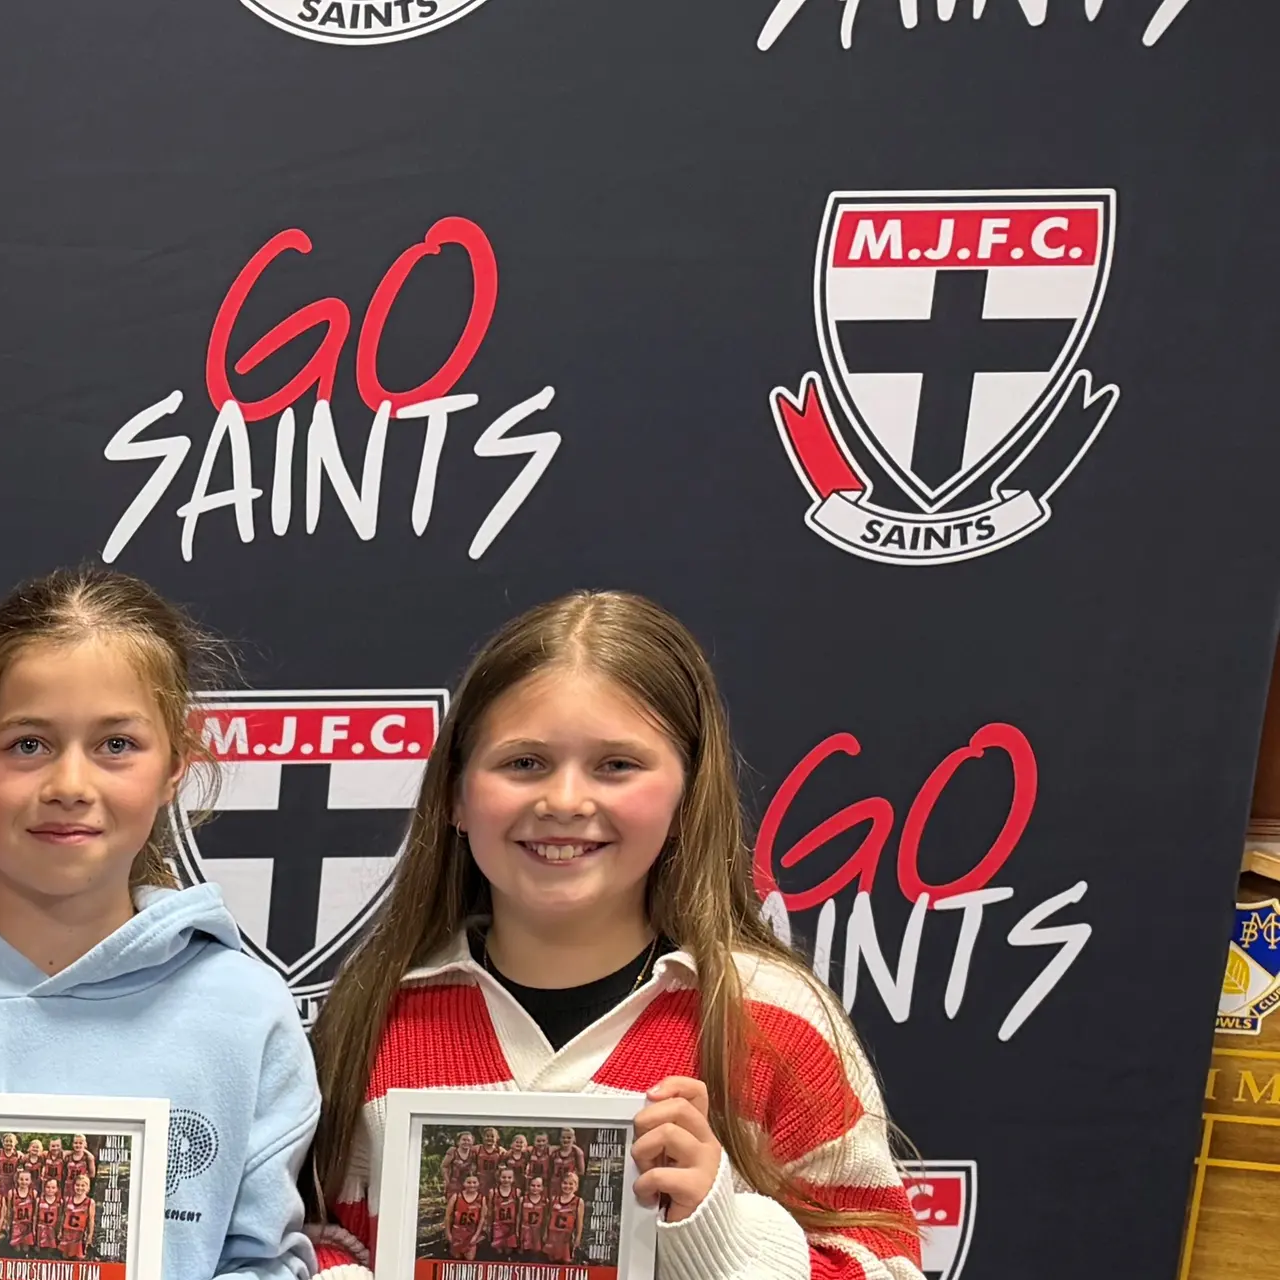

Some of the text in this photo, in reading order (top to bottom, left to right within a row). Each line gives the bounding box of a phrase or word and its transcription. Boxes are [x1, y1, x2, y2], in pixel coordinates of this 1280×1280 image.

[297, 0, 439, 30] SAINTS
[848, 216, 1083, 261] M.J.F.C.
[205, 215, 498, 422] GO
[102, 385, 561, 564] SAINTS
[859, 515, 996, 551] SAINTS
[754, 722, 1038, 912] GO
